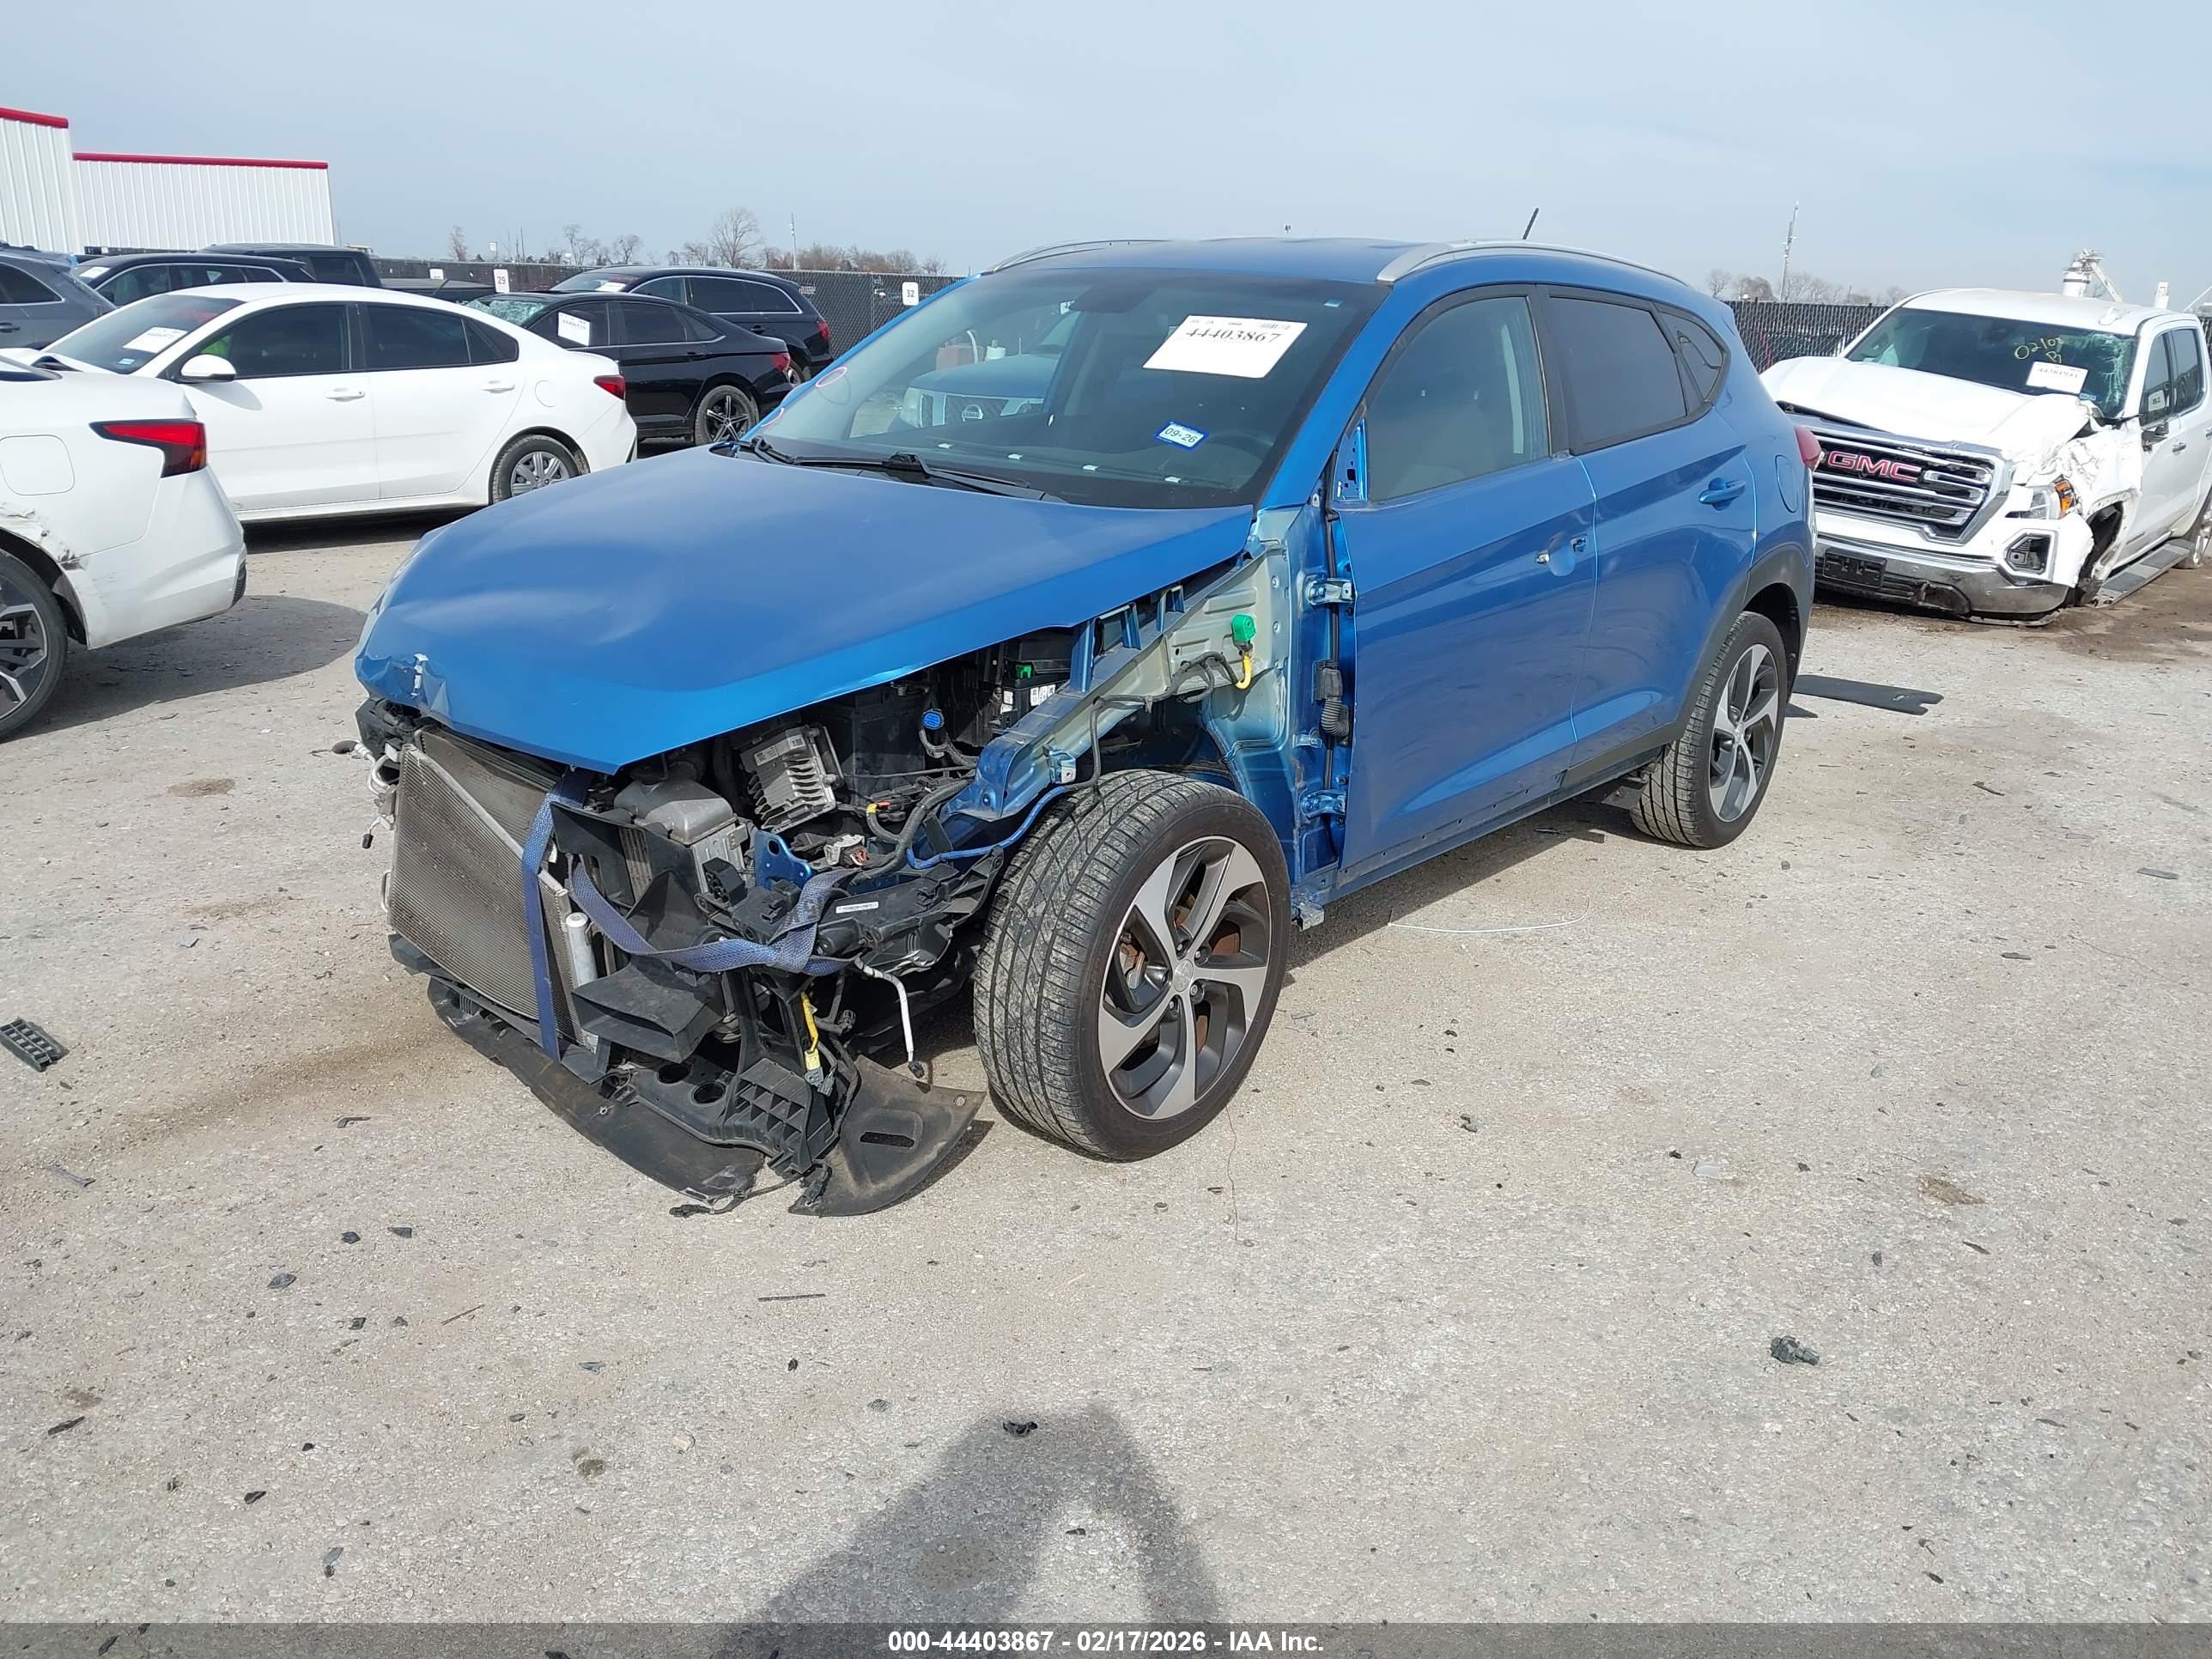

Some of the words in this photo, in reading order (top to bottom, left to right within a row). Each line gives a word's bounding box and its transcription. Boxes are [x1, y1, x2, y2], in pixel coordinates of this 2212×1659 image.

[496, 276, 506, 285] 29
[906, 289, 915, 298] 32
[1186, 327, 1283, 343] 44403867
[1827, 451, 1922, 482] GMC
